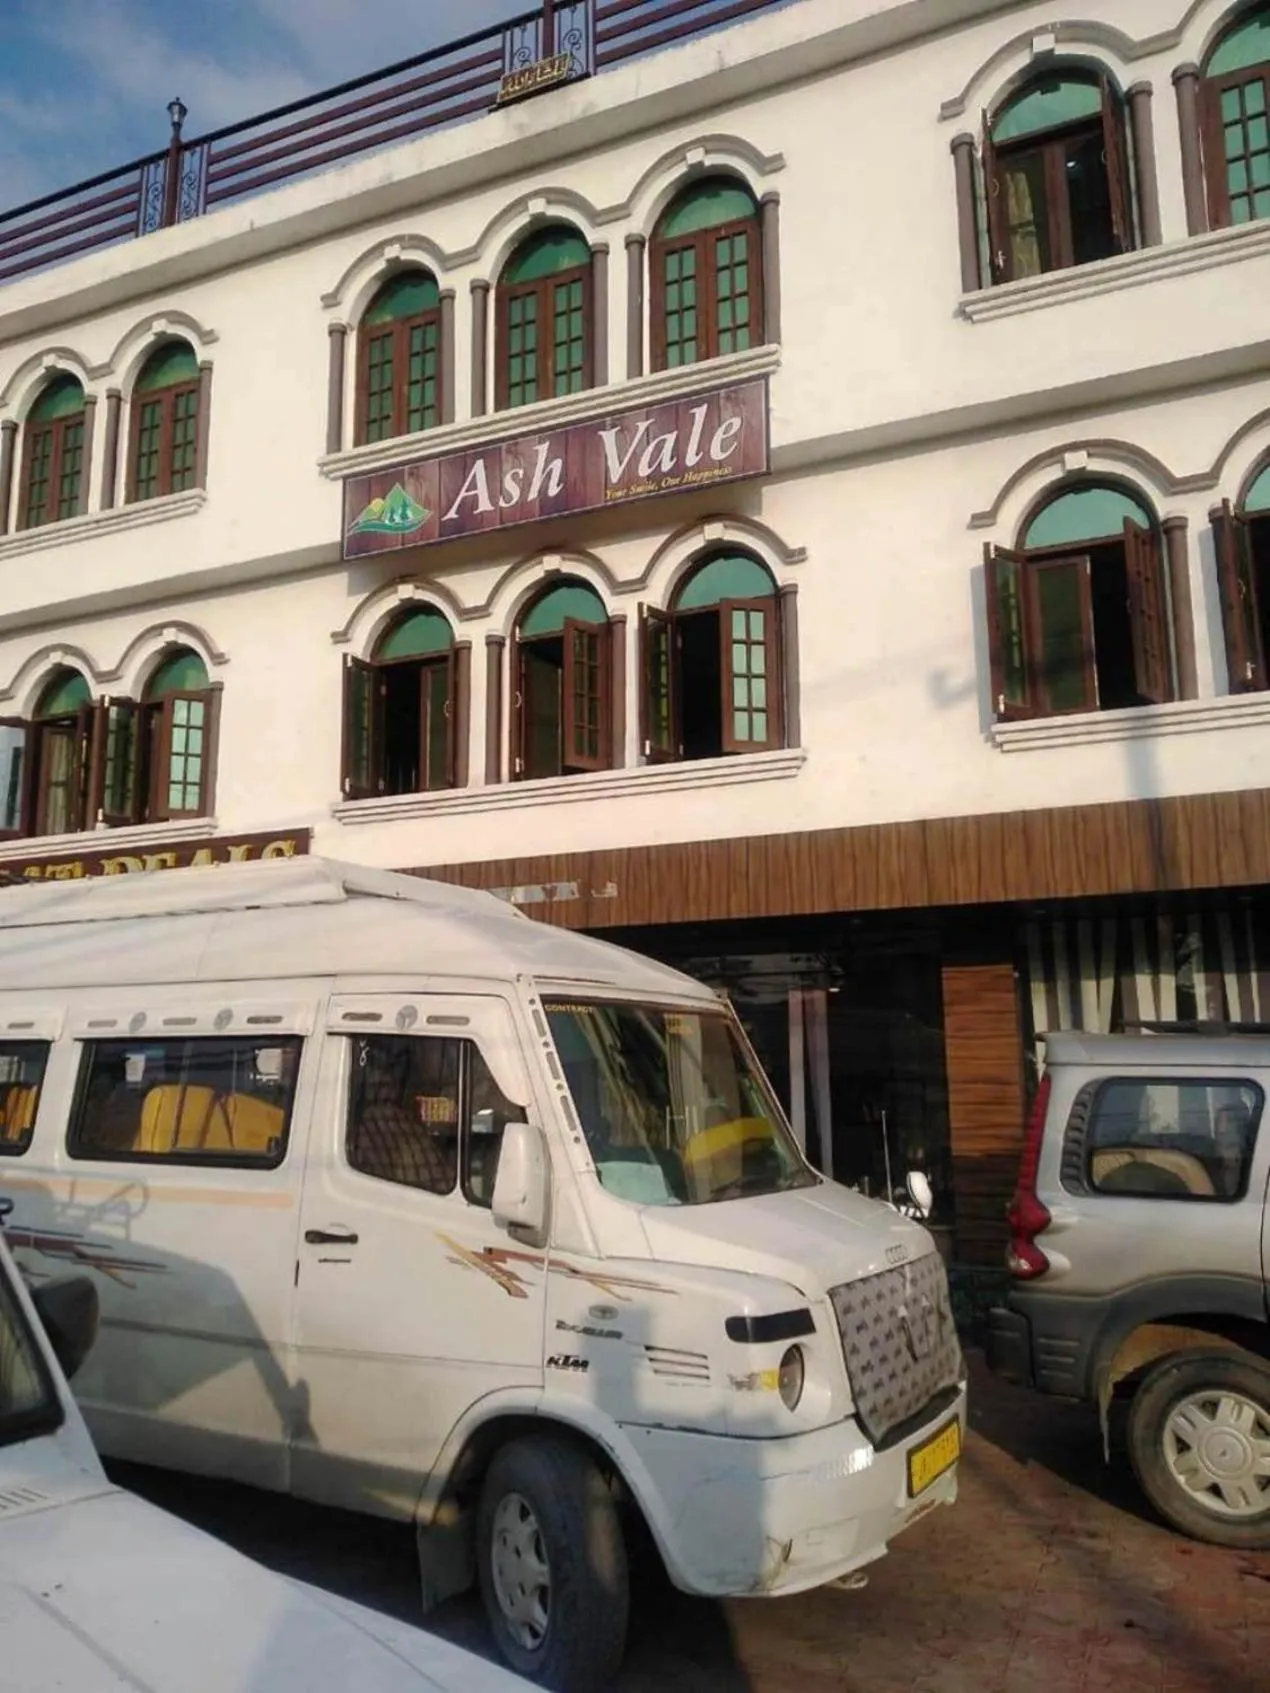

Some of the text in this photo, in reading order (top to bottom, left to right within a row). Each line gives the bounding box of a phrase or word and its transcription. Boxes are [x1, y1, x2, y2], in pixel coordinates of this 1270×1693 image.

[442, 403, 742, 521] Ash Vale
[683, 467, 733, 483] Happiness
